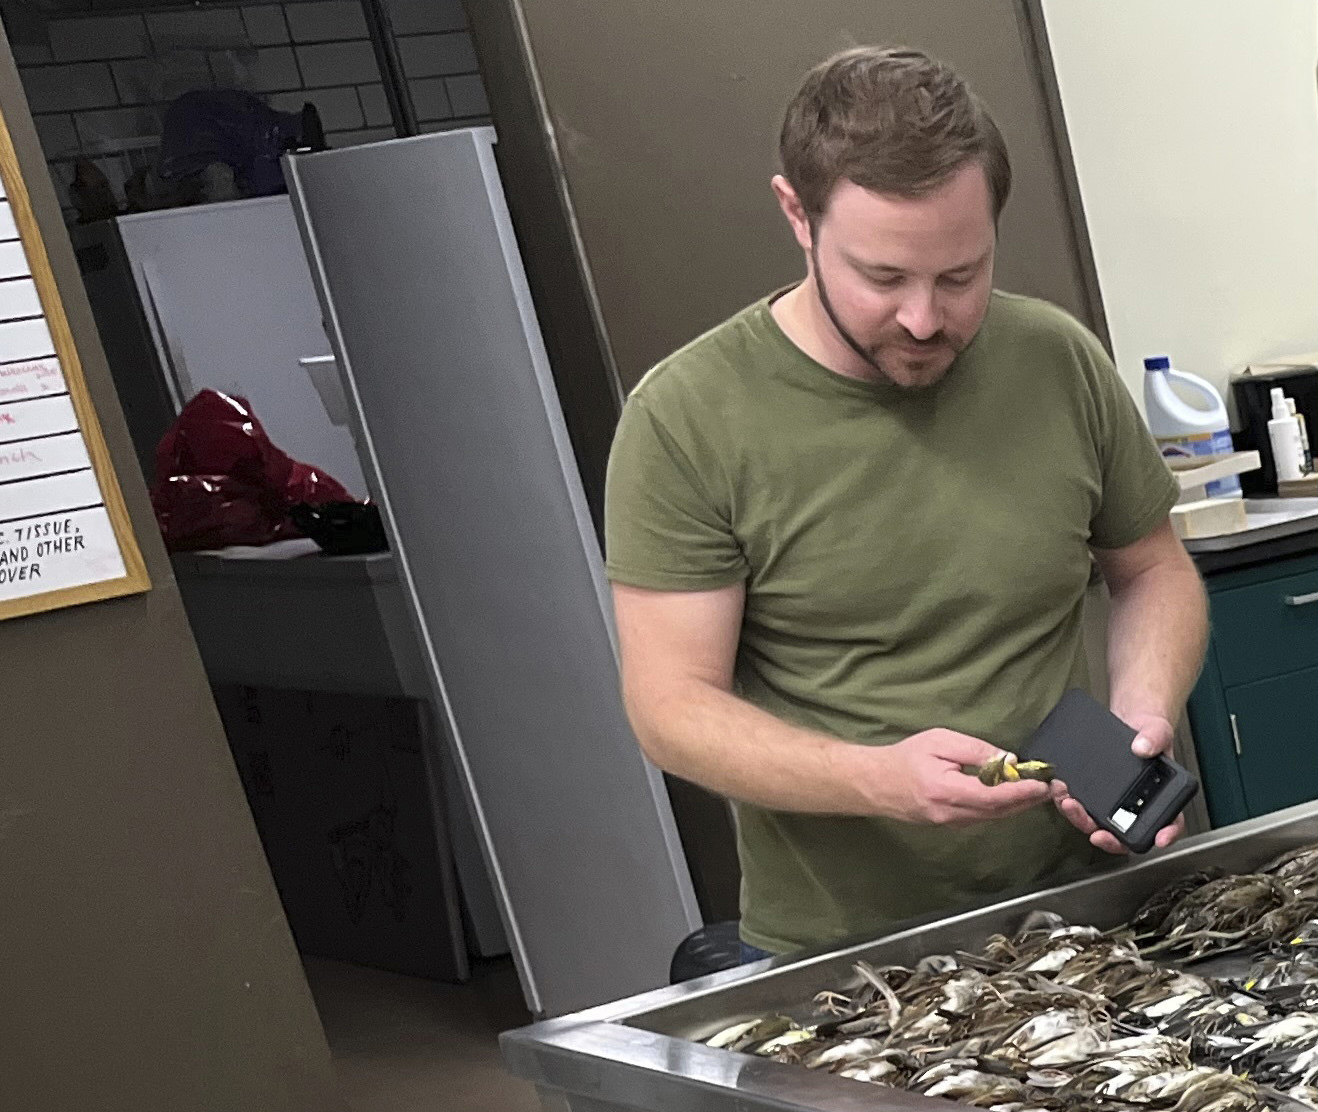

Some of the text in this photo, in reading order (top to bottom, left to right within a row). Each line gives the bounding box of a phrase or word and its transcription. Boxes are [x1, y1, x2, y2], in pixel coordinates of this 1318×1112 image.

[15, 518, 80, 542] TISSUE,
[0, 535, 85, 566] AND OTHER
